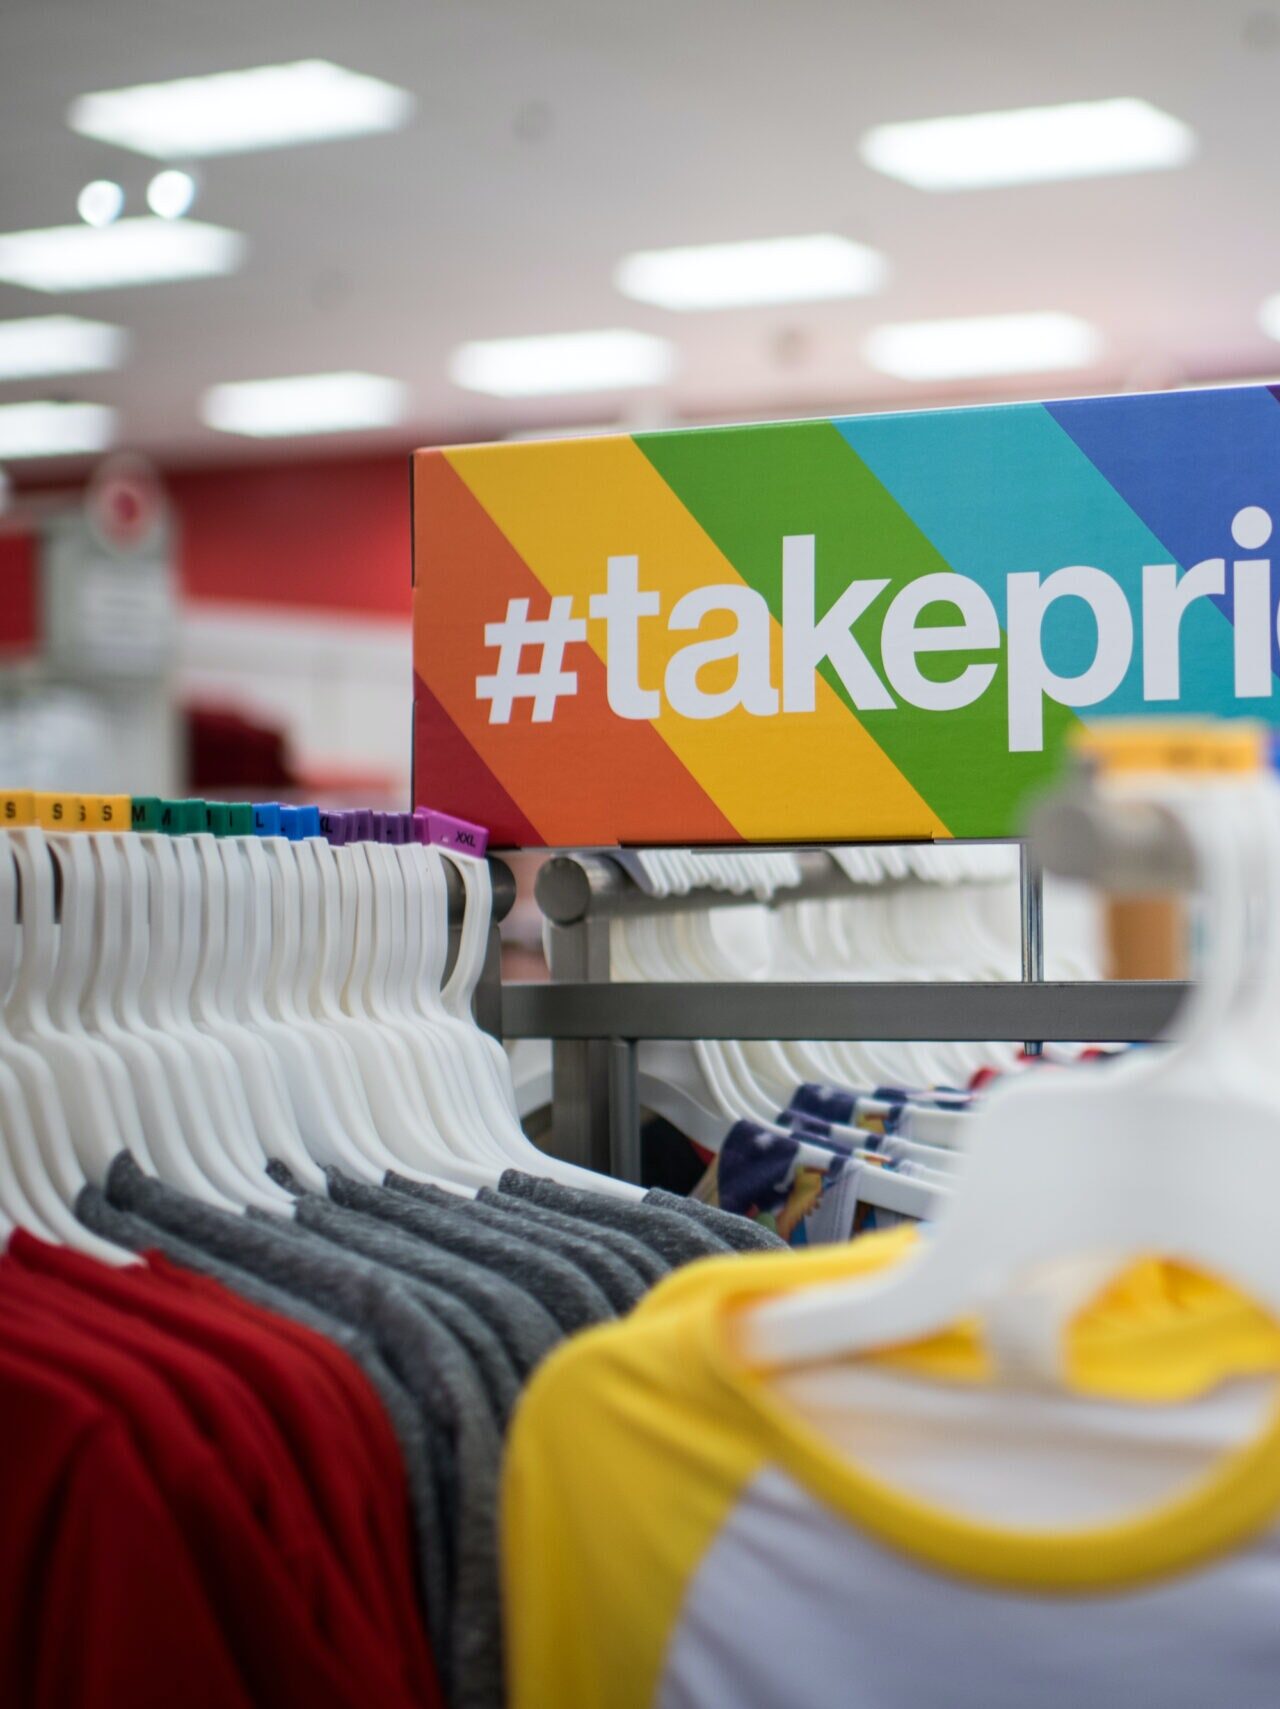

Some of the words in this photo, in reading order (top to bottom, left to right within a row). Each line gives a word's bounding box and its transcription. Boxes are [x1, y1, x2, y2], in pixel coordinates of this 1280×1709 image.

[5, 801, 17, 819] S
[52, 802, 64, 820] S
[101, 804, 114, 822] S
[255, 811, 265, 828] L
[456, 831, 477, 848] XXL
